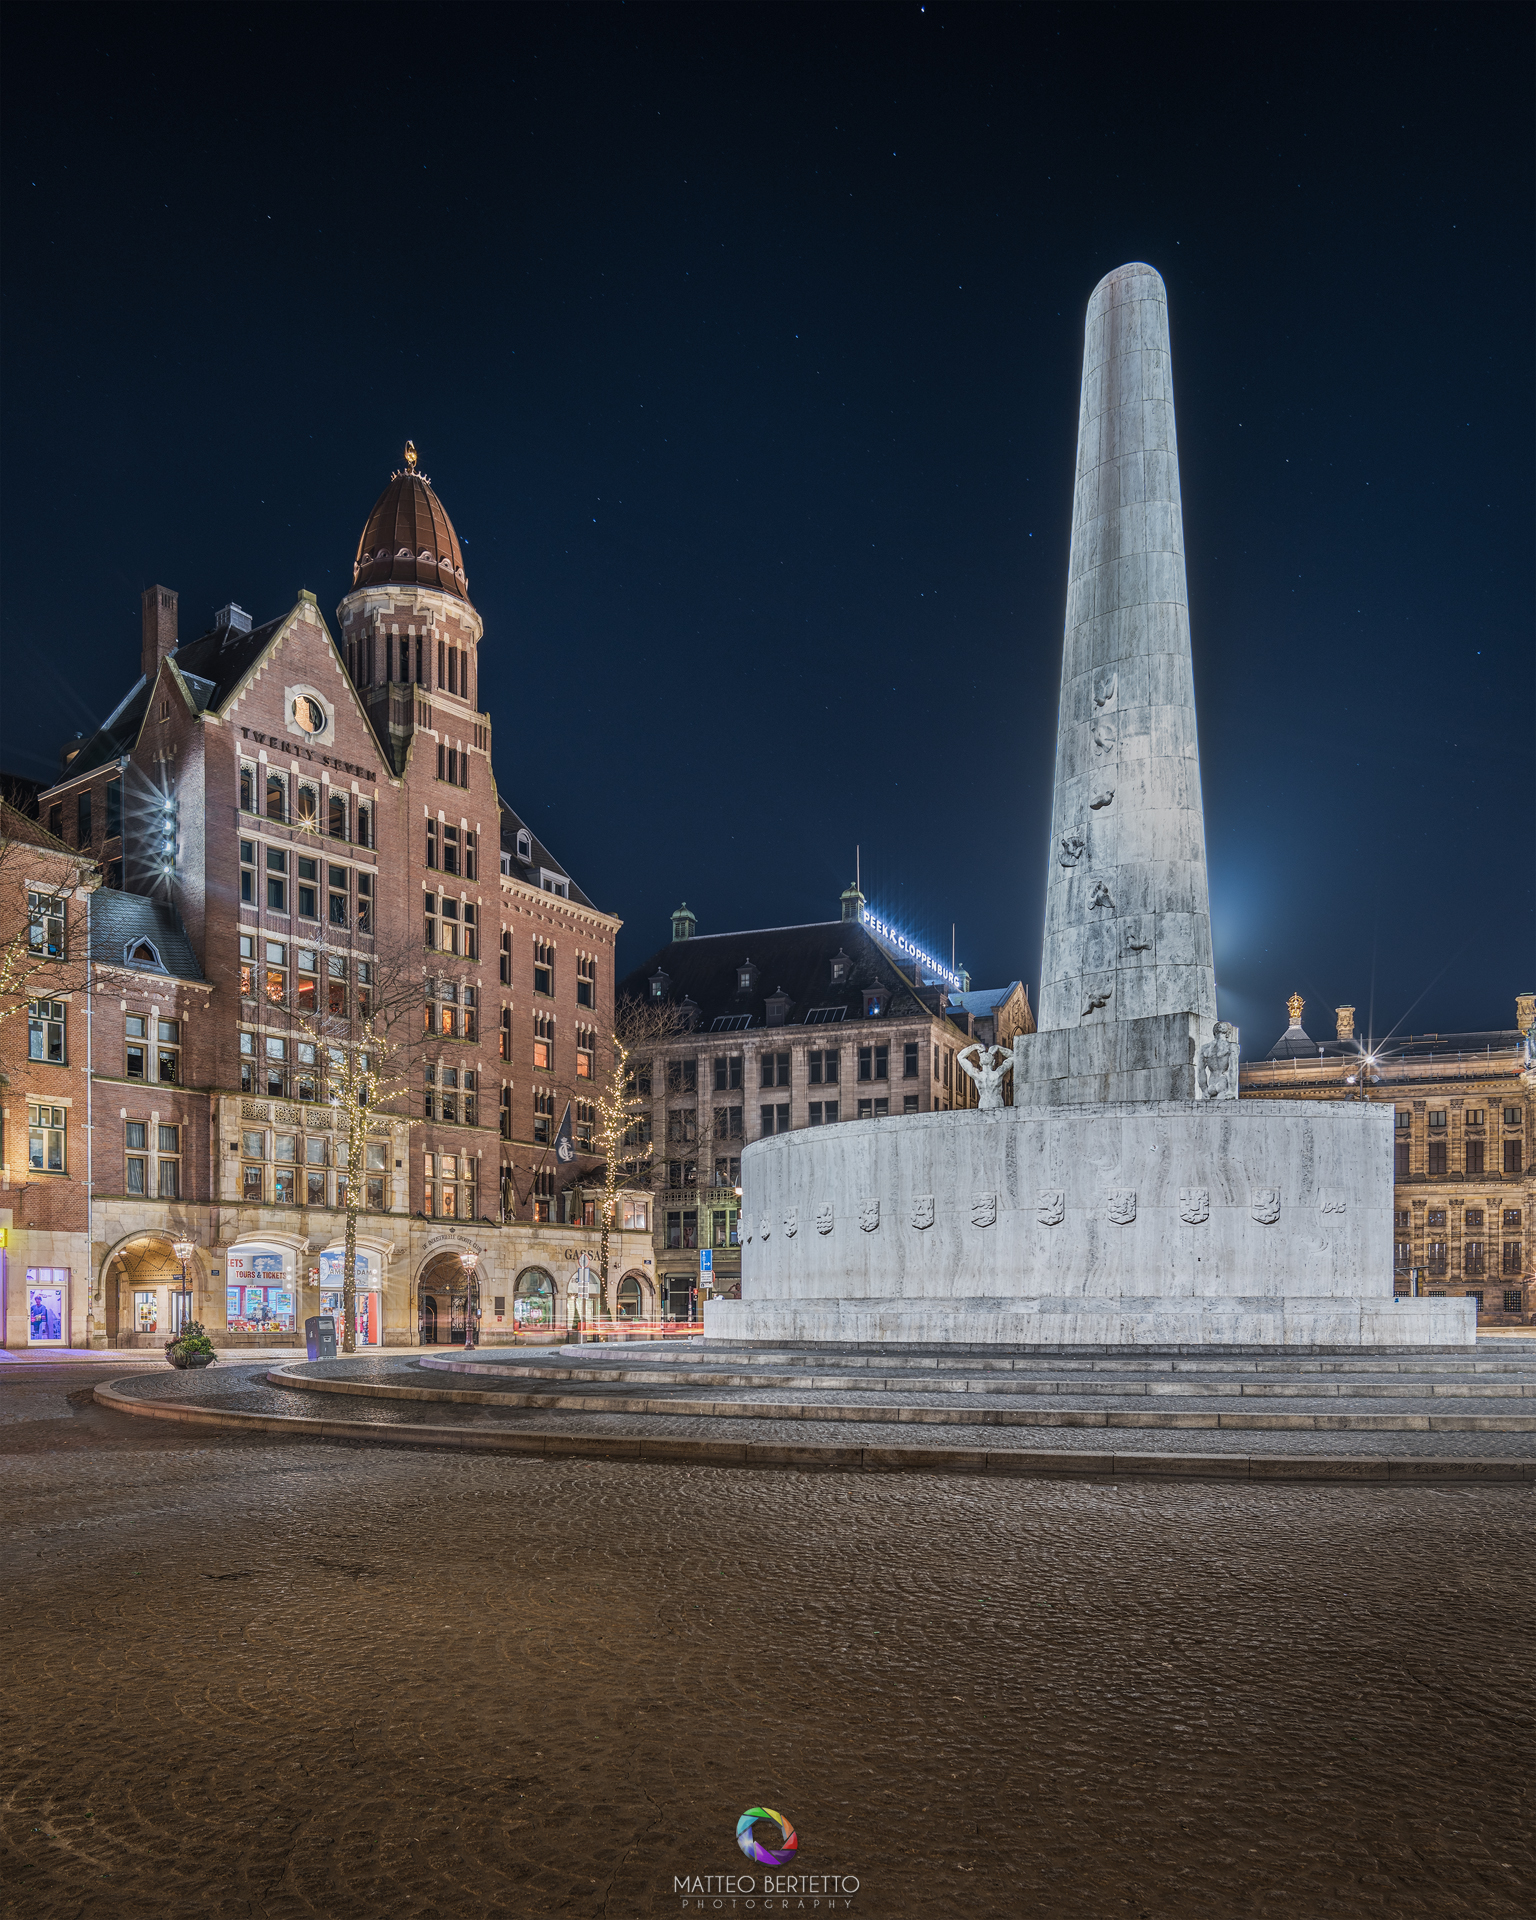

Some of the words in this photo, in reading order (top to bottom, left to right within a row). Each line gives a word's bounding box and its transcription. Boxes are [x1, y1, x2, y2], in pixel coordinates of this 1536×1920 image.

[241, 726, 314, 761] TWENTY
[323, 756, 377, 782] SEVEN
[863, 910, 888, 938] PEEK
[889, 929, 898, 945] &
[898, 936, 960, 987] CLOPPENBURG
[473, 1242, 483, 1254] CLUB
[564, 1248, 602, 1261] GASA
[235, 1270, 256, 1279] TOURS
[256, 1271, 262, 1279] &
[262, 1271, 287, 1280] TICKETS
